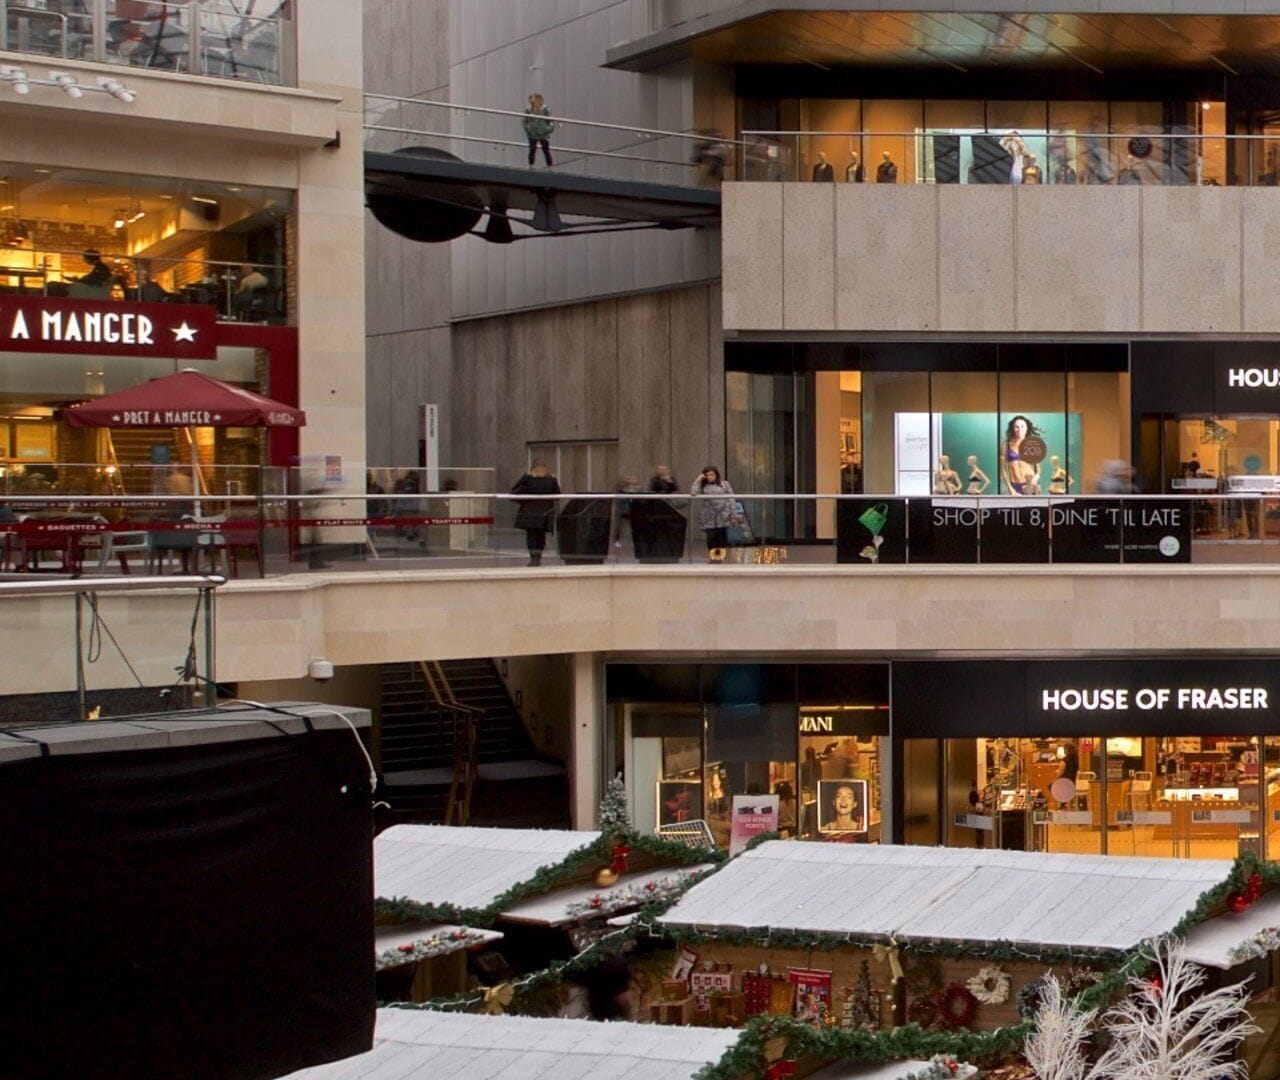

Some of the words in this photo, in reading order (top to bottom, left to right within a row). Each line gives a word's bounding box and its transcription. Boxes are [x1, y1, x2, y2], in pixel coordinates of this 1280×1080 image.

[11, 309, 30, 340] A
[42, 309, 154, 345] MANGER
[124, 411, 148, 424] PRET
[151, 411, 161, 424] A
[165, 411, 210, 424] MANGER
[933, 508, 993, 526] SHOP
[1051, 508, 1098, 526] DINE
[1142, 508, 1180, 526] LATE
[1042, 689, 1128, 710] HOUSE
[1135, 689, 1169, 710] OF
[1177, 689, 1268, 710] FRASER
